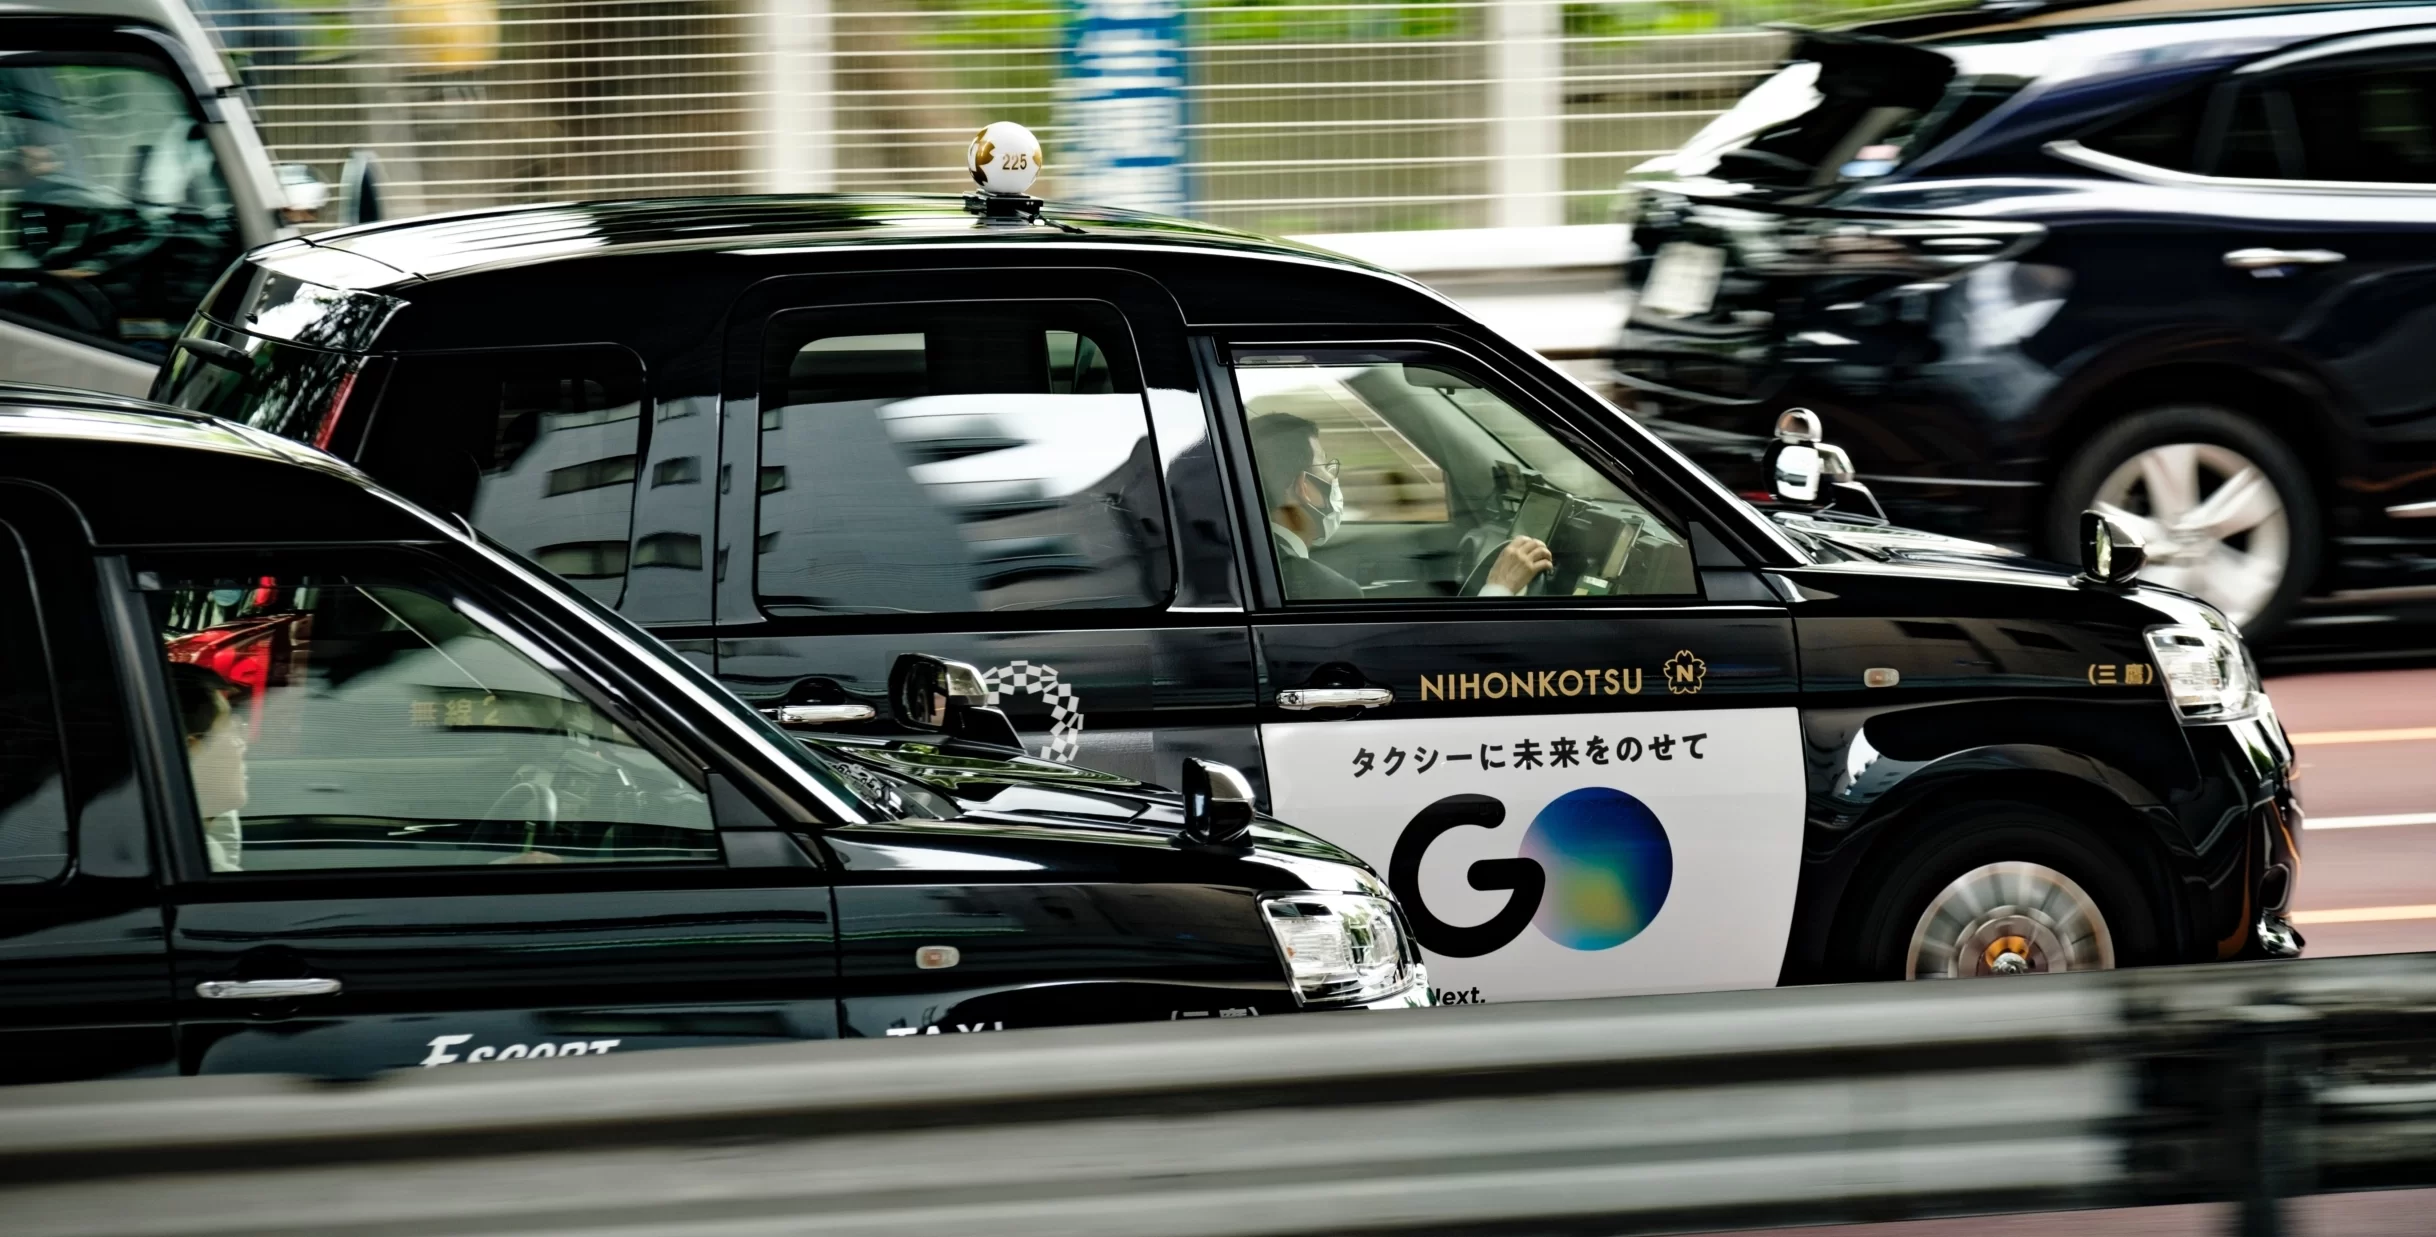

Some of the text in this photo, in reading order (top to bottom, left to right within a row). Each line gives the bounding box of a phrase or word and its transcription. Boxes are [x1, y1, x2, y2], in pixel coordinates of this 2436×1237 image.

[1002, 154, 1027, 170] 225
[1420, 667, 1643, 701] NIHONKOTSU
[1352, 732, 1708, 778] タクシーに未来をのせて
